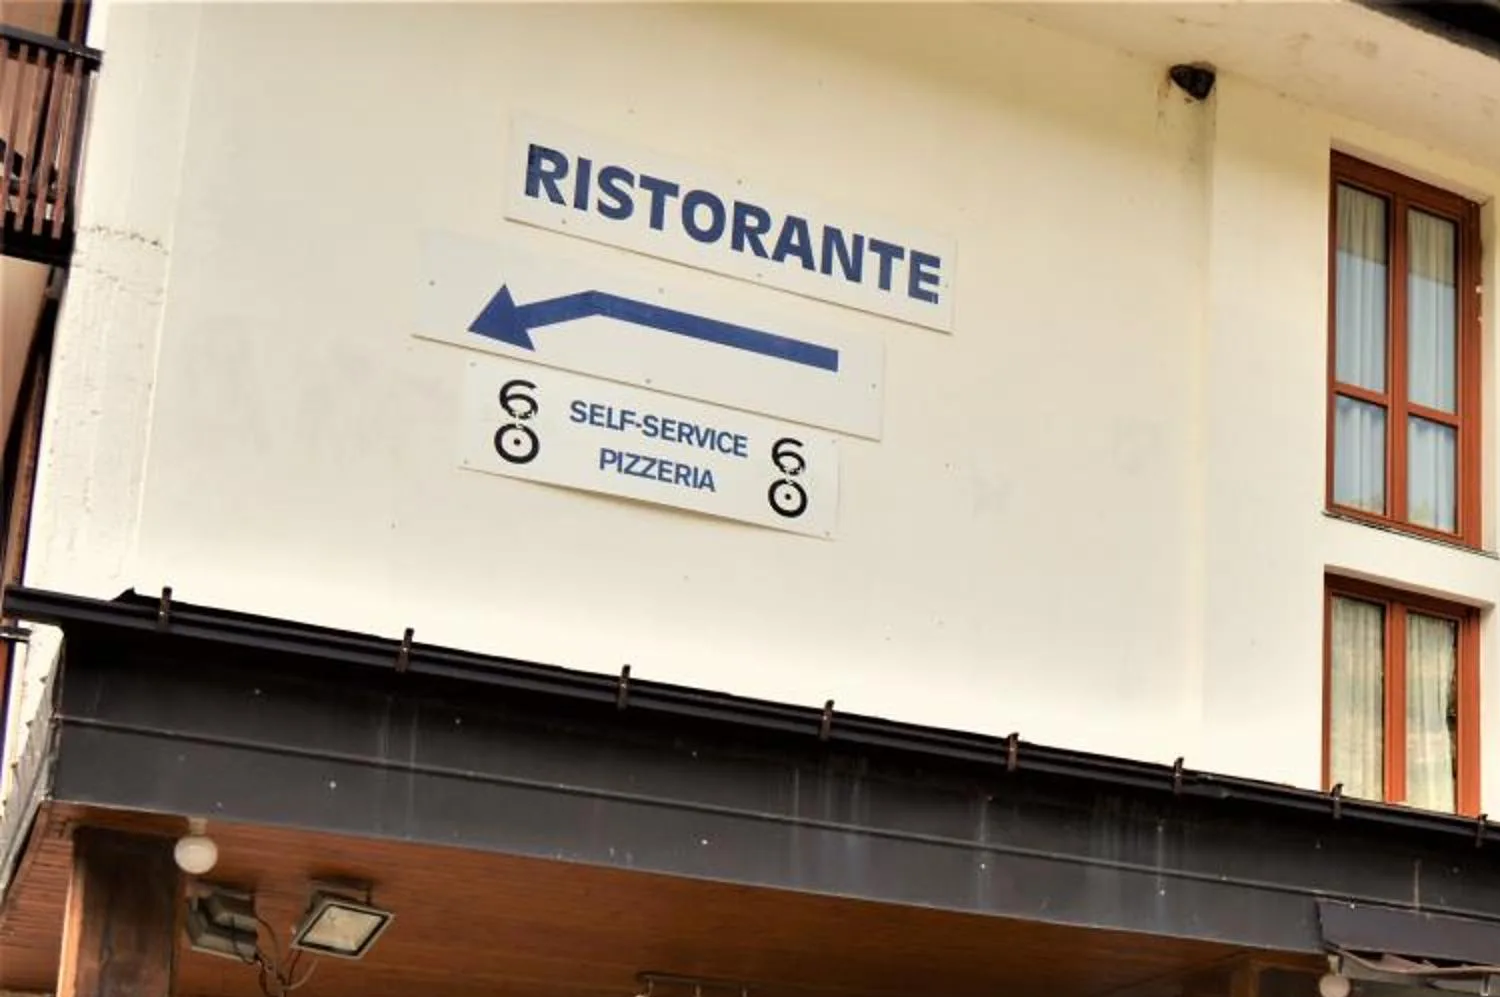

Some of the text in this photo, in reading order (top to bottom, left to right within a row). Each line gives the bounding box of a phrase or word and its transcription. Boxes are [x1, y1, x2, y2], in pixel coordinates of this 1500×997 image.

[524, 143, 941, 304] RISTORANTE
[569, 400, 748, 458] SELF-SERVICE
[600, 447, 715, 492] PIZZERIA
